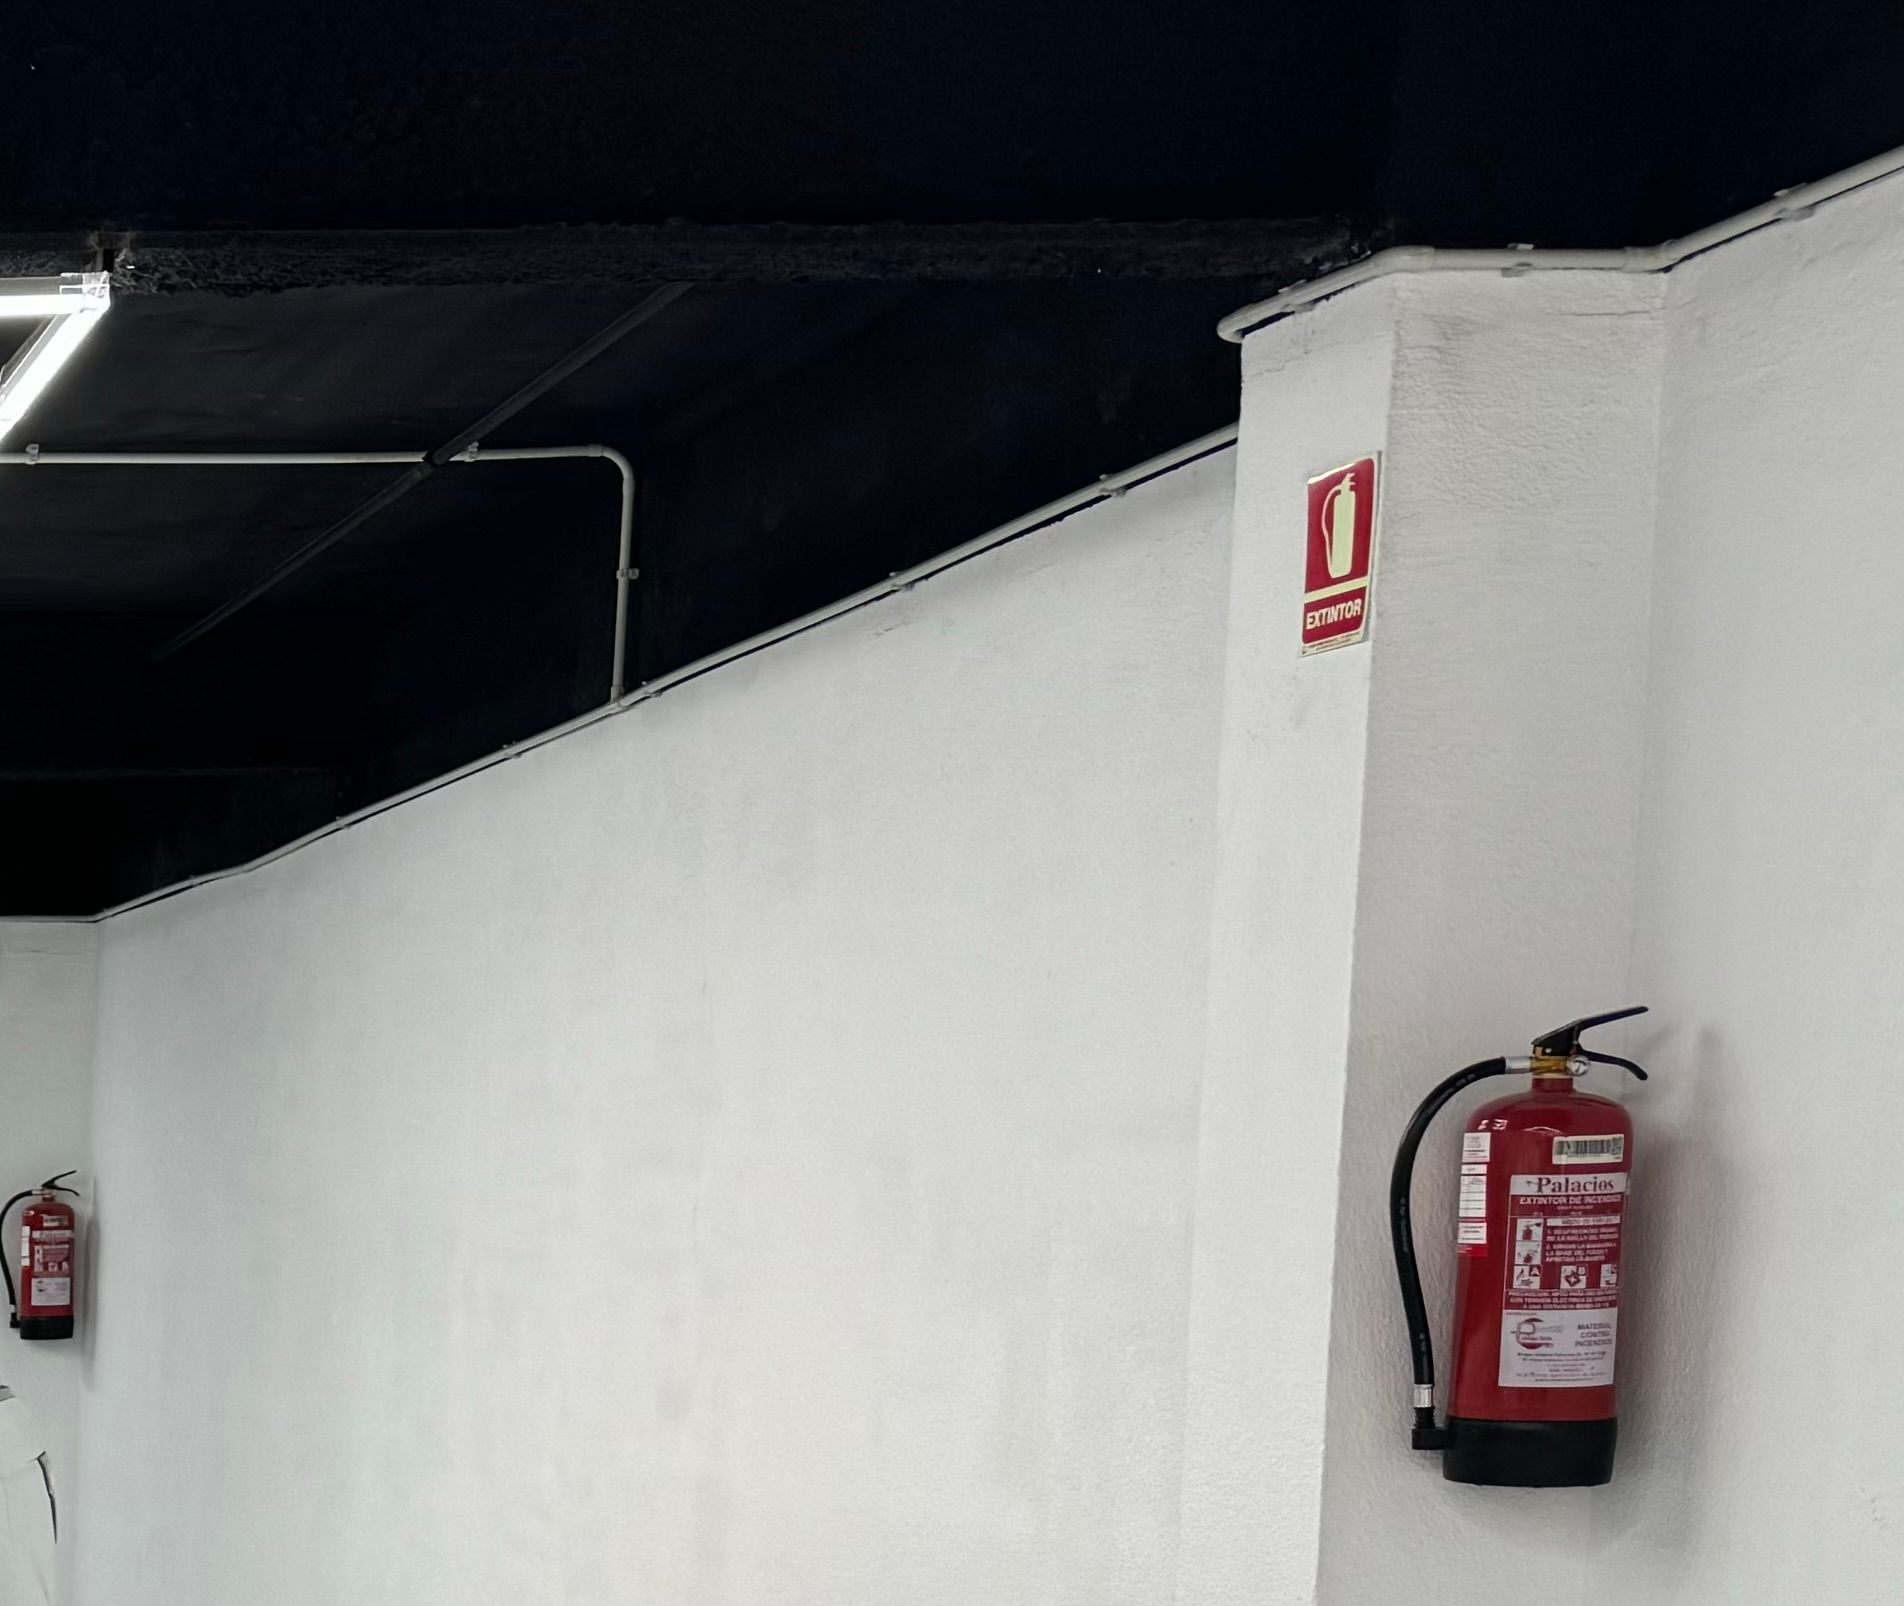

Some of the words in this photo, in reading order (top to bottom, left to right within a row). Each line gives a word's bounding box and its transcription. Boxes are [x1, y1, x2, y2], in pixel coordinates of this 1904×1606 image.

[1306, 598, 1362, 629] EXTINTOR
[1536, 1176, 1615, 1193] Palacios
[1519, 1196, 1567, 1205] EXTINTOR
[1569, 1196, 1582, 1205] DE
